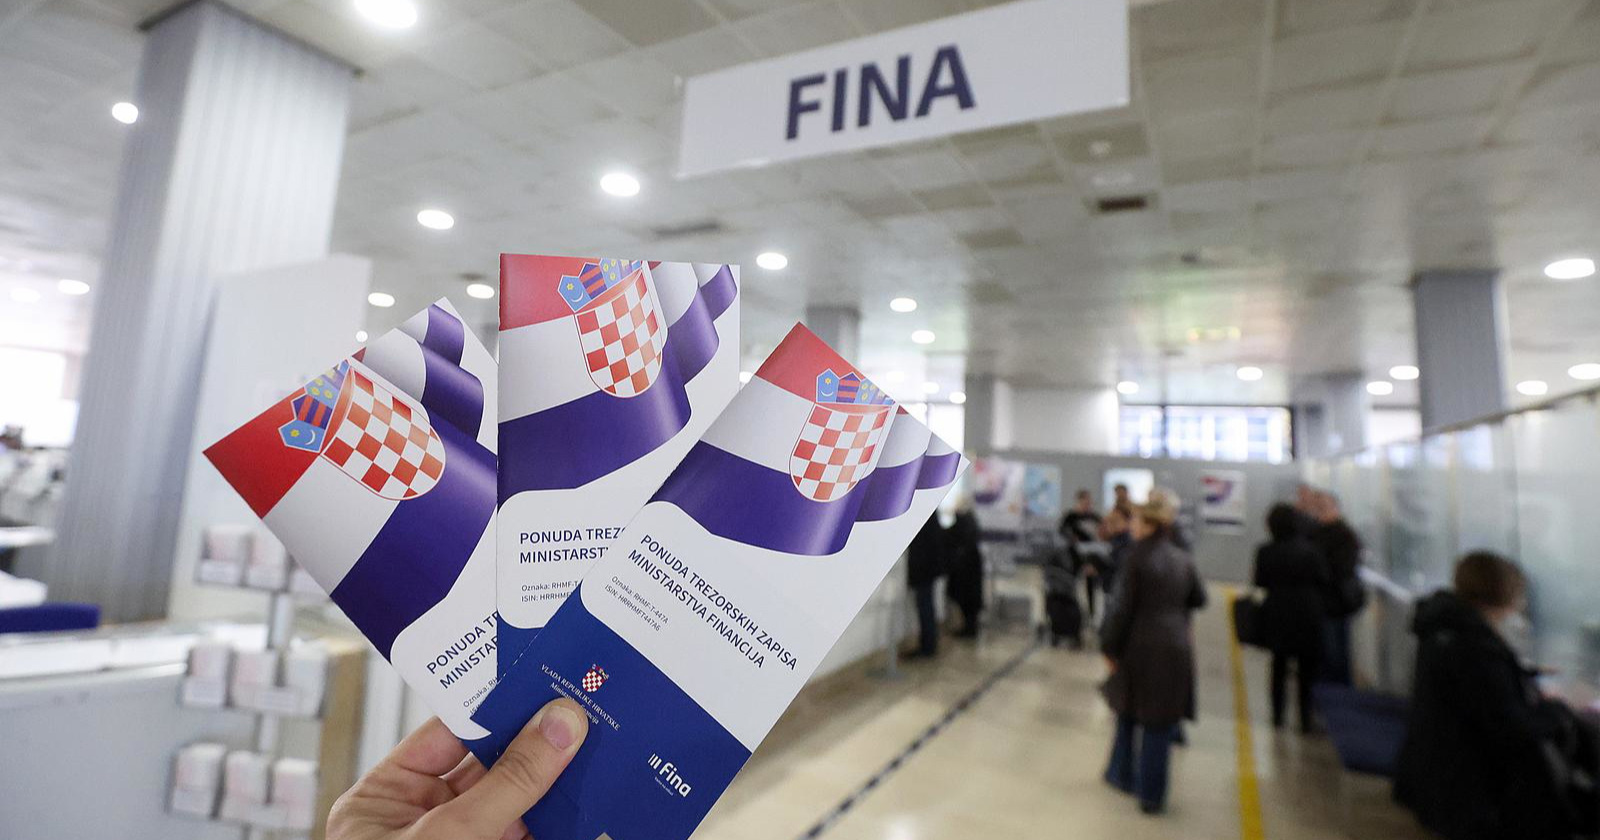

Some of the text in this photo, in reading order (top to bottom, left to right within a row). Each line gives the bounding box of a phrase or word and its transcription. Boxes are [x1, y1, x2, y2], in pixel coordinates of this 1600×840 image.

[785, 42, 976, 141] FINA
[520, 527, 626, 544] PONUDA TREZ
[519, 546, 609, 564] MINISTARST
[521, 582, 550, 592] Oznaka:
[604, 584, 617, 598] ISIN:
[611, 576, 633, 596] Oznaka:
[521, 594, 538, 602] ISIN:
[628, 549, 766, 669] MINISTARSTVA FINANCIJA
[640, 534, 798, 671] PONUDA TREZORSKIH ZAPISA
[426, 626, 486, 675] PONUDA
[463, 684, 489, 708] Oznaka:
[541, 663, 620, 731] VLADA REPUBLIKE HRVATSKE
